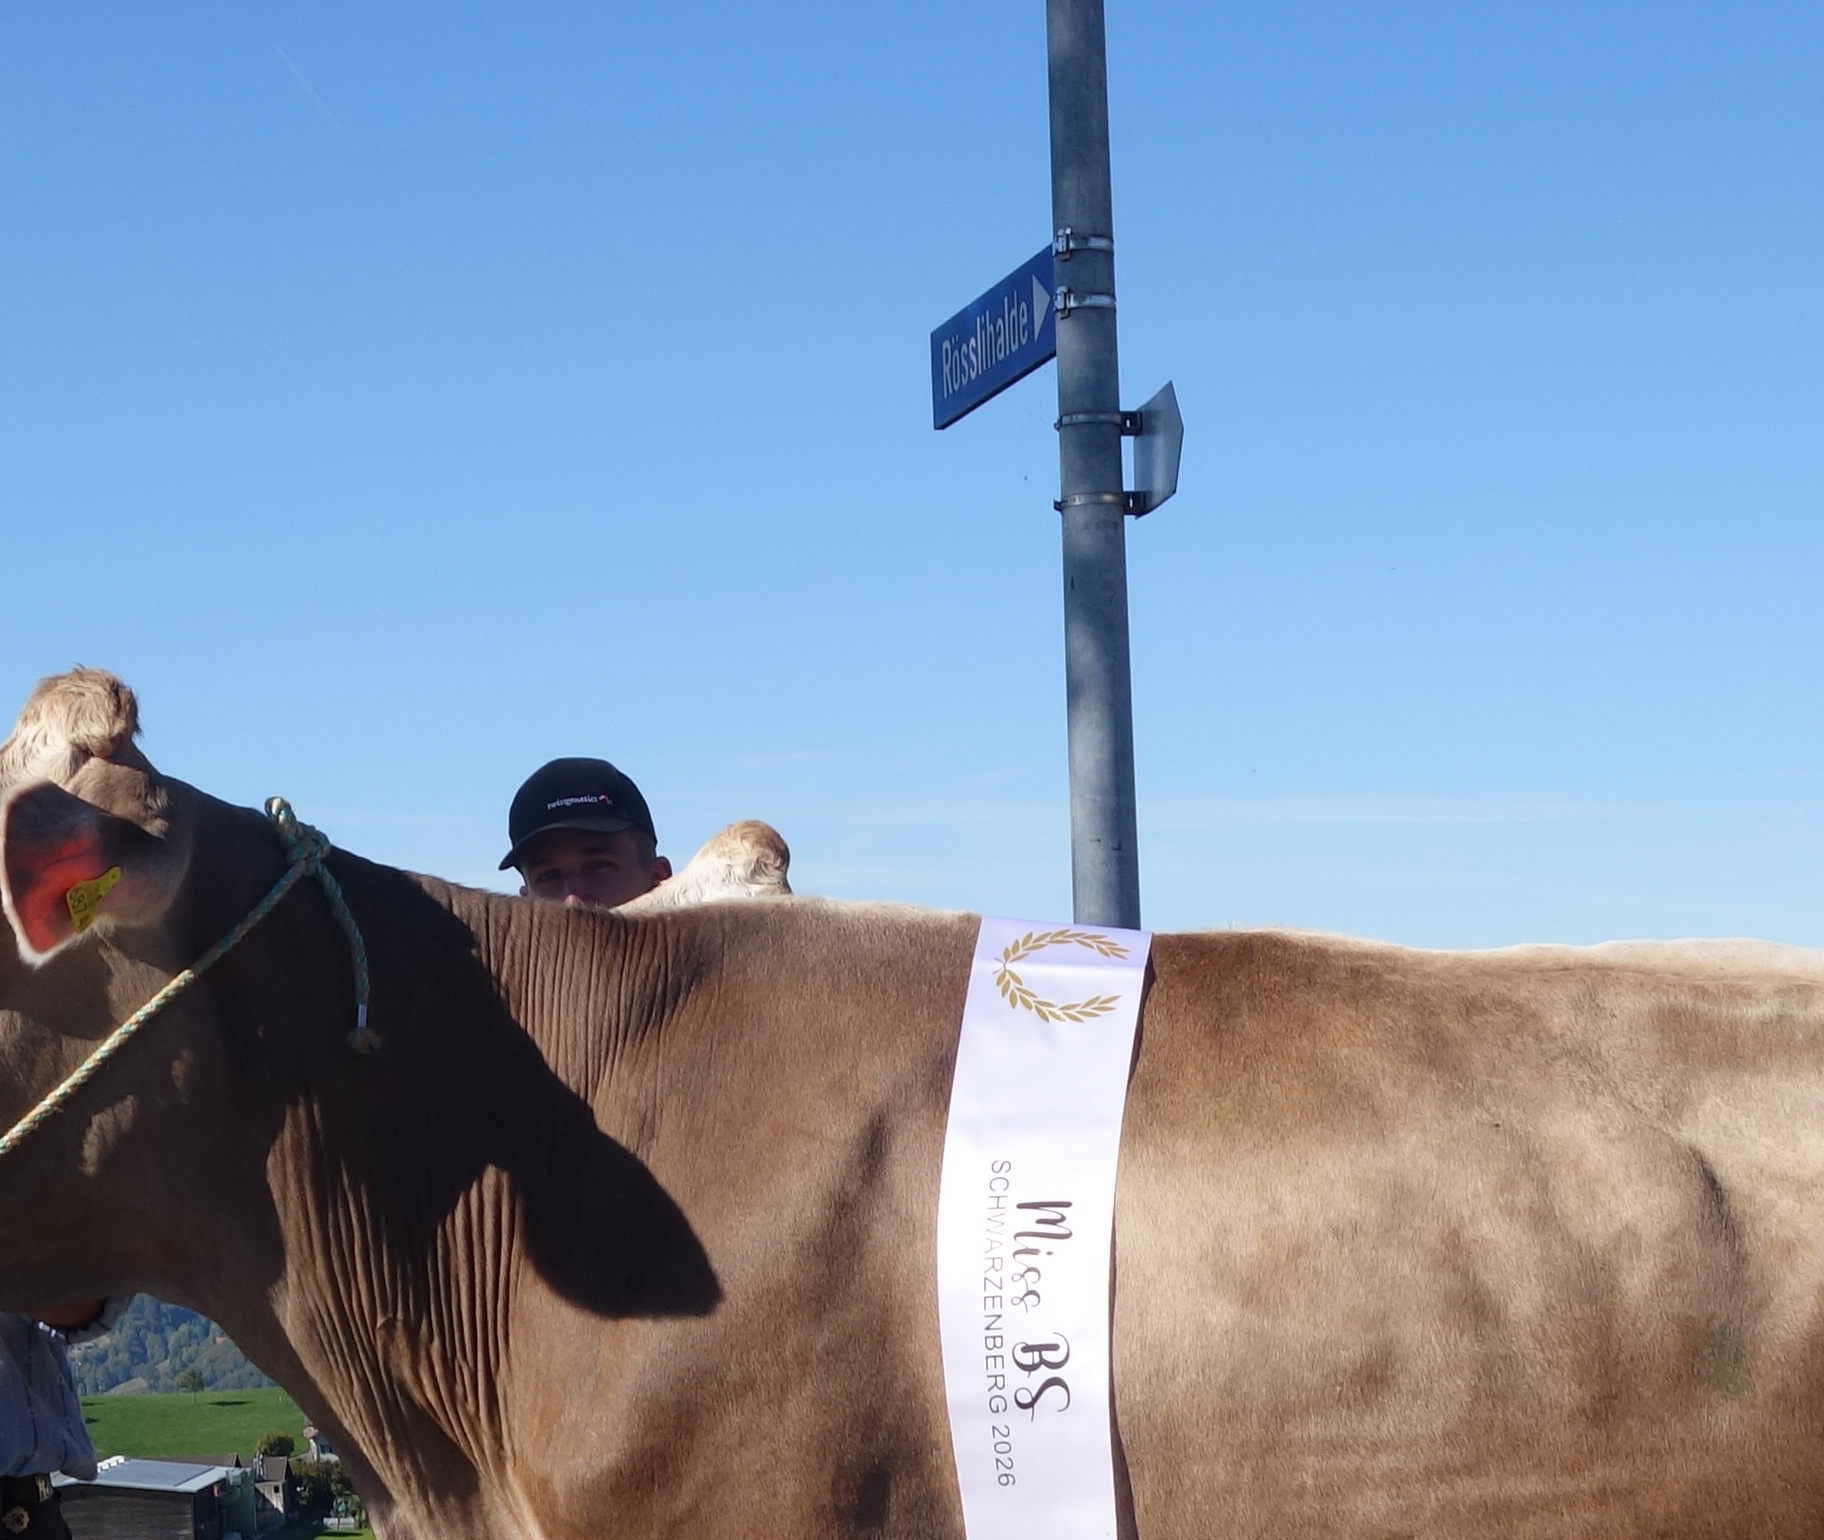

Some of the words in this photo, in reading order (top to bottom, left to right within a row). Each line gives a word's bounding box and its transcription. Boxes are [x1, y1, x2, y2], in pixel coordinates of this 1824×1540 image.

[942, 290, 1028, 398] Rösslihalde
[983, 1160, 1012, 1414] SCHWARZENBERG
[1010, 1201, 1073, 1313] Miss
[1012, 1332, 1071, 1421] BS
[991, 1424, 1016, 1487] 2026
